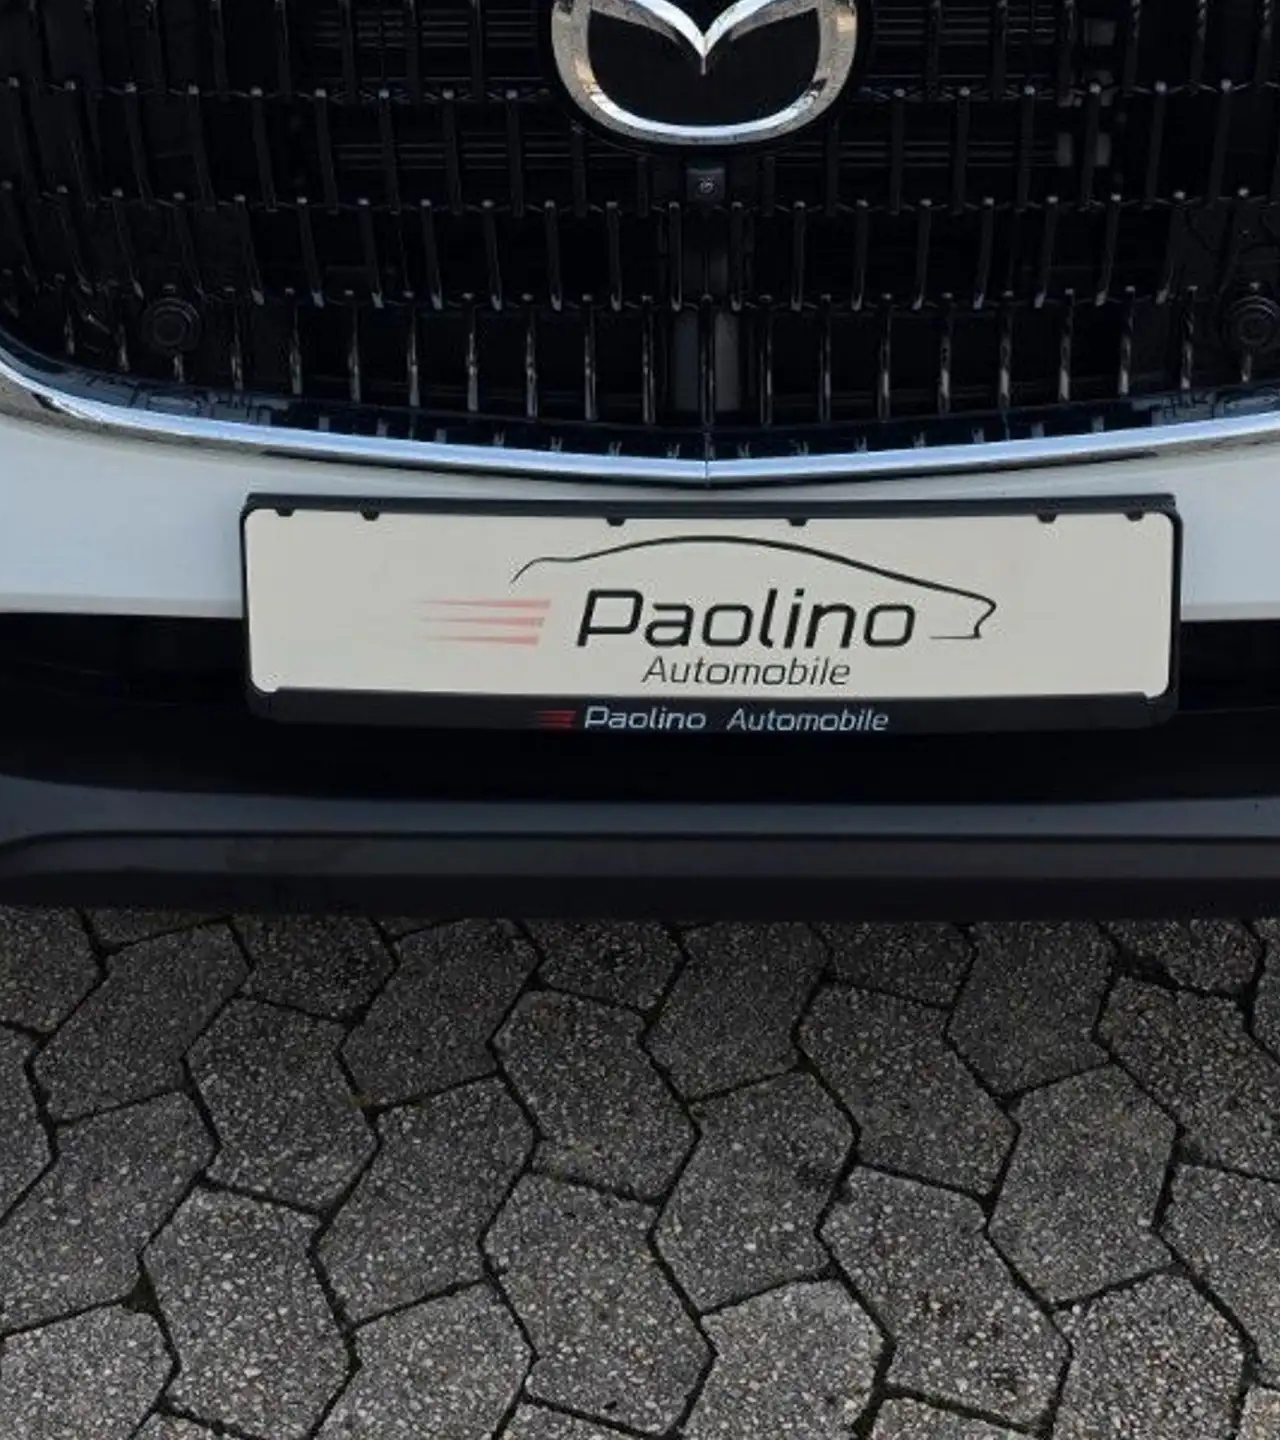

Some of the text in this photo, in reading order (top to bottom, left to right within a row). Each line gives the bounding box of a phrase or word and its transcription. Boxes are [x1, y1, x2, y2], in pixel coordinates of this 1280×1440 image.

[576, 587, 917, 649] Paolino
[640, 655, 852, 686] Automobile
[583, 705, 890, 732] Paolino Automobile
